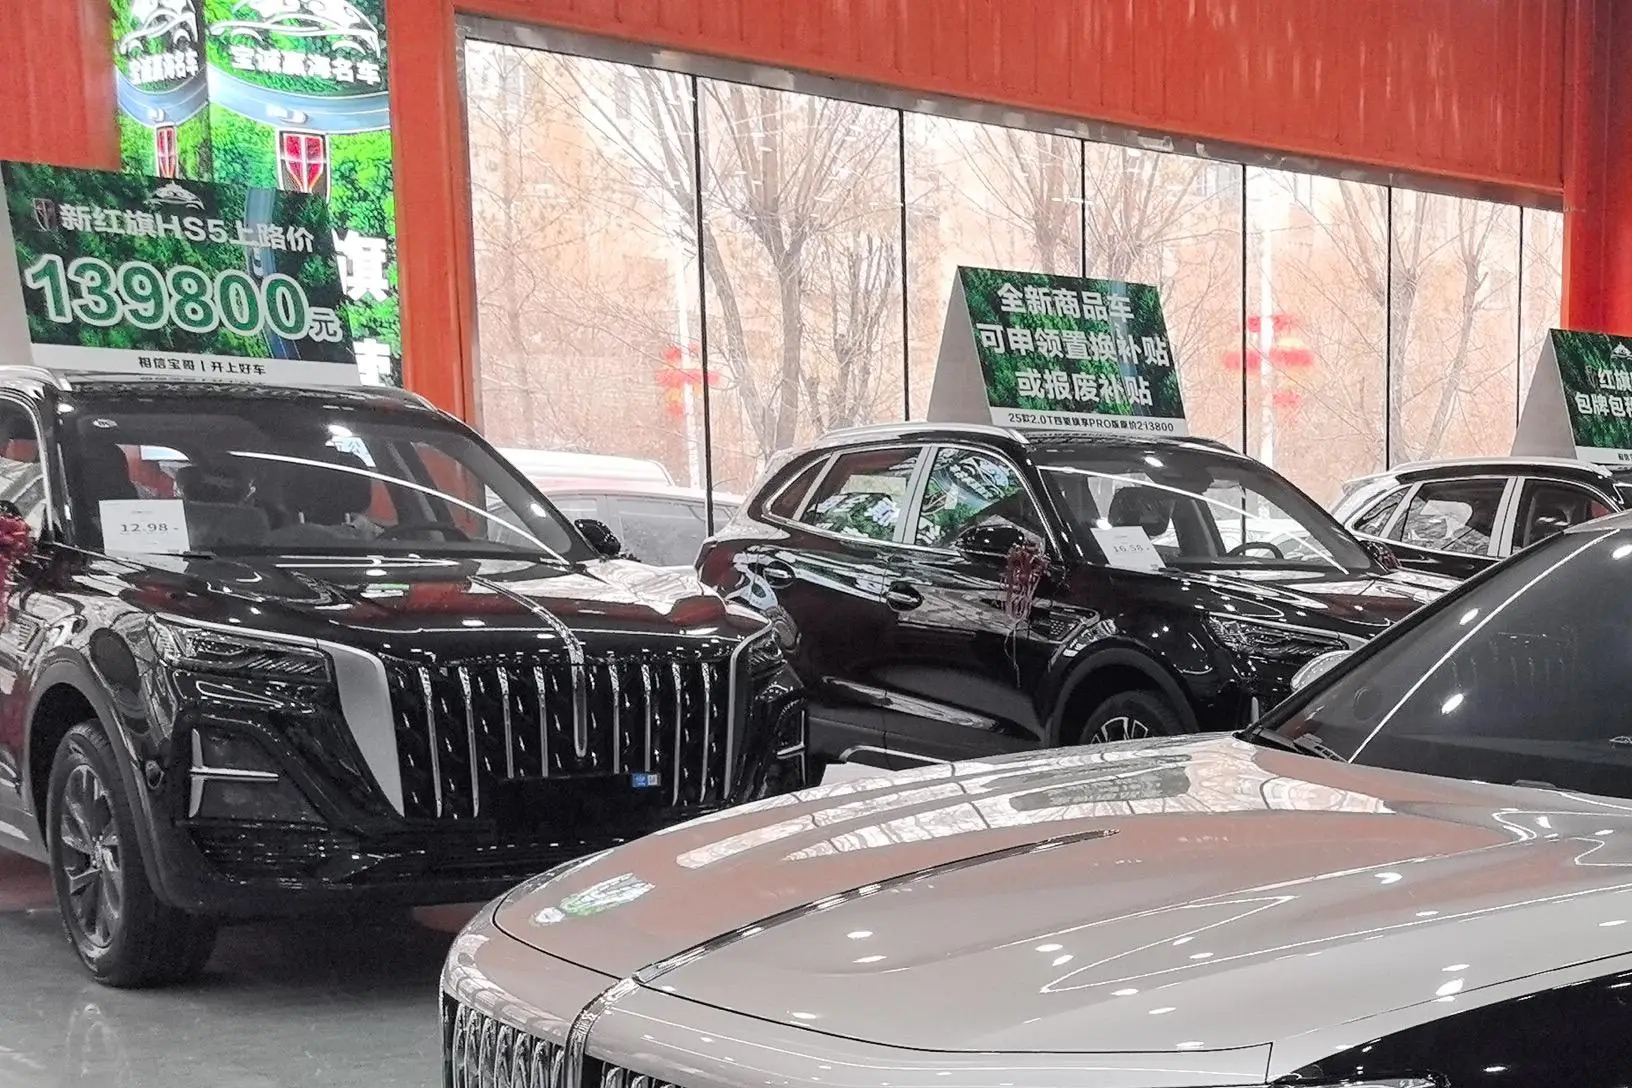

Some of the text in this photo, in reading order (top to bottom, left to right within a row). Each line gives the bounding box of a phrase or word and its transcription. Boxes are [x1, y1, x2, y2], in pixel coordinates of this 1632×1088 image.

[58, 202, 315, 253] 新红旗HS5上路价
[25, 253, 344, 343] 139800元
[997, 282, 1135, 323] 全新商品车
[976, 322, 1171, 368] 可申领置换补贴
[1015, 367, 1154, 407] 或报废补贴
